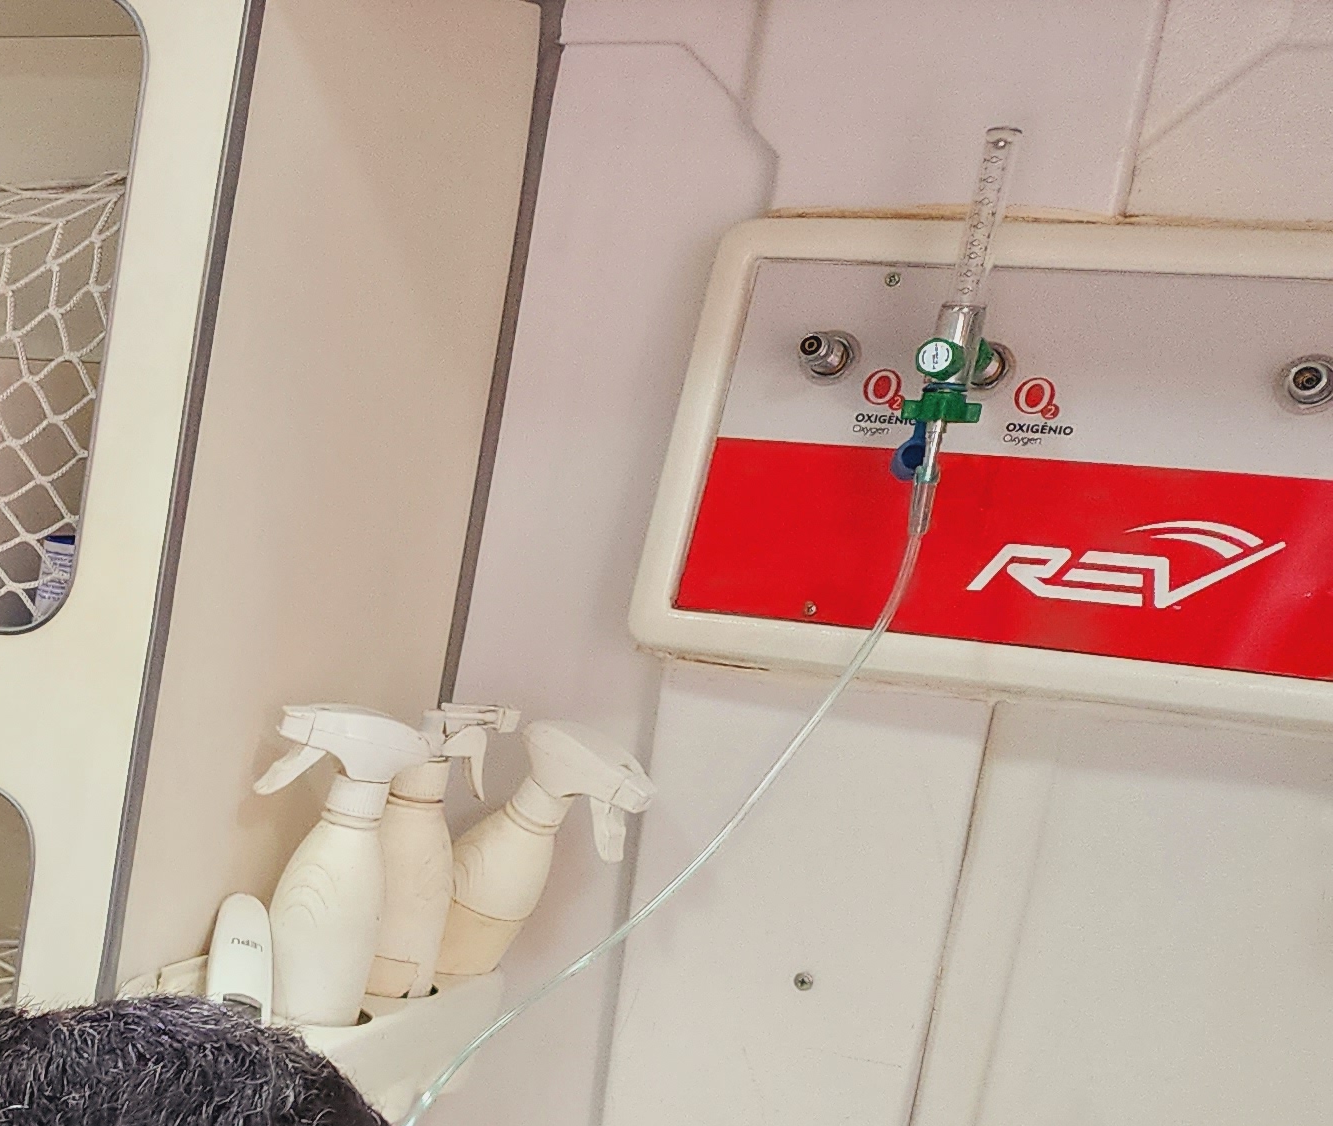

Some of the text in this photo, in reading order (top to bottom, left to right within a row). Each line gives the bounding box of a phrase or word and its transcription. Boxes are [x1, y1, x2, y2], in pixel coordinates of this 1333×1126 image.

[853, 424, 890, 436] Oxygen
[1006, 422, 1074, 436] OXIGÊNIO
[1003, 433, 1042, 446] Oxygen
[966, 543, 1287, 609] REV
[230, 937, 263, 952] LEPU
